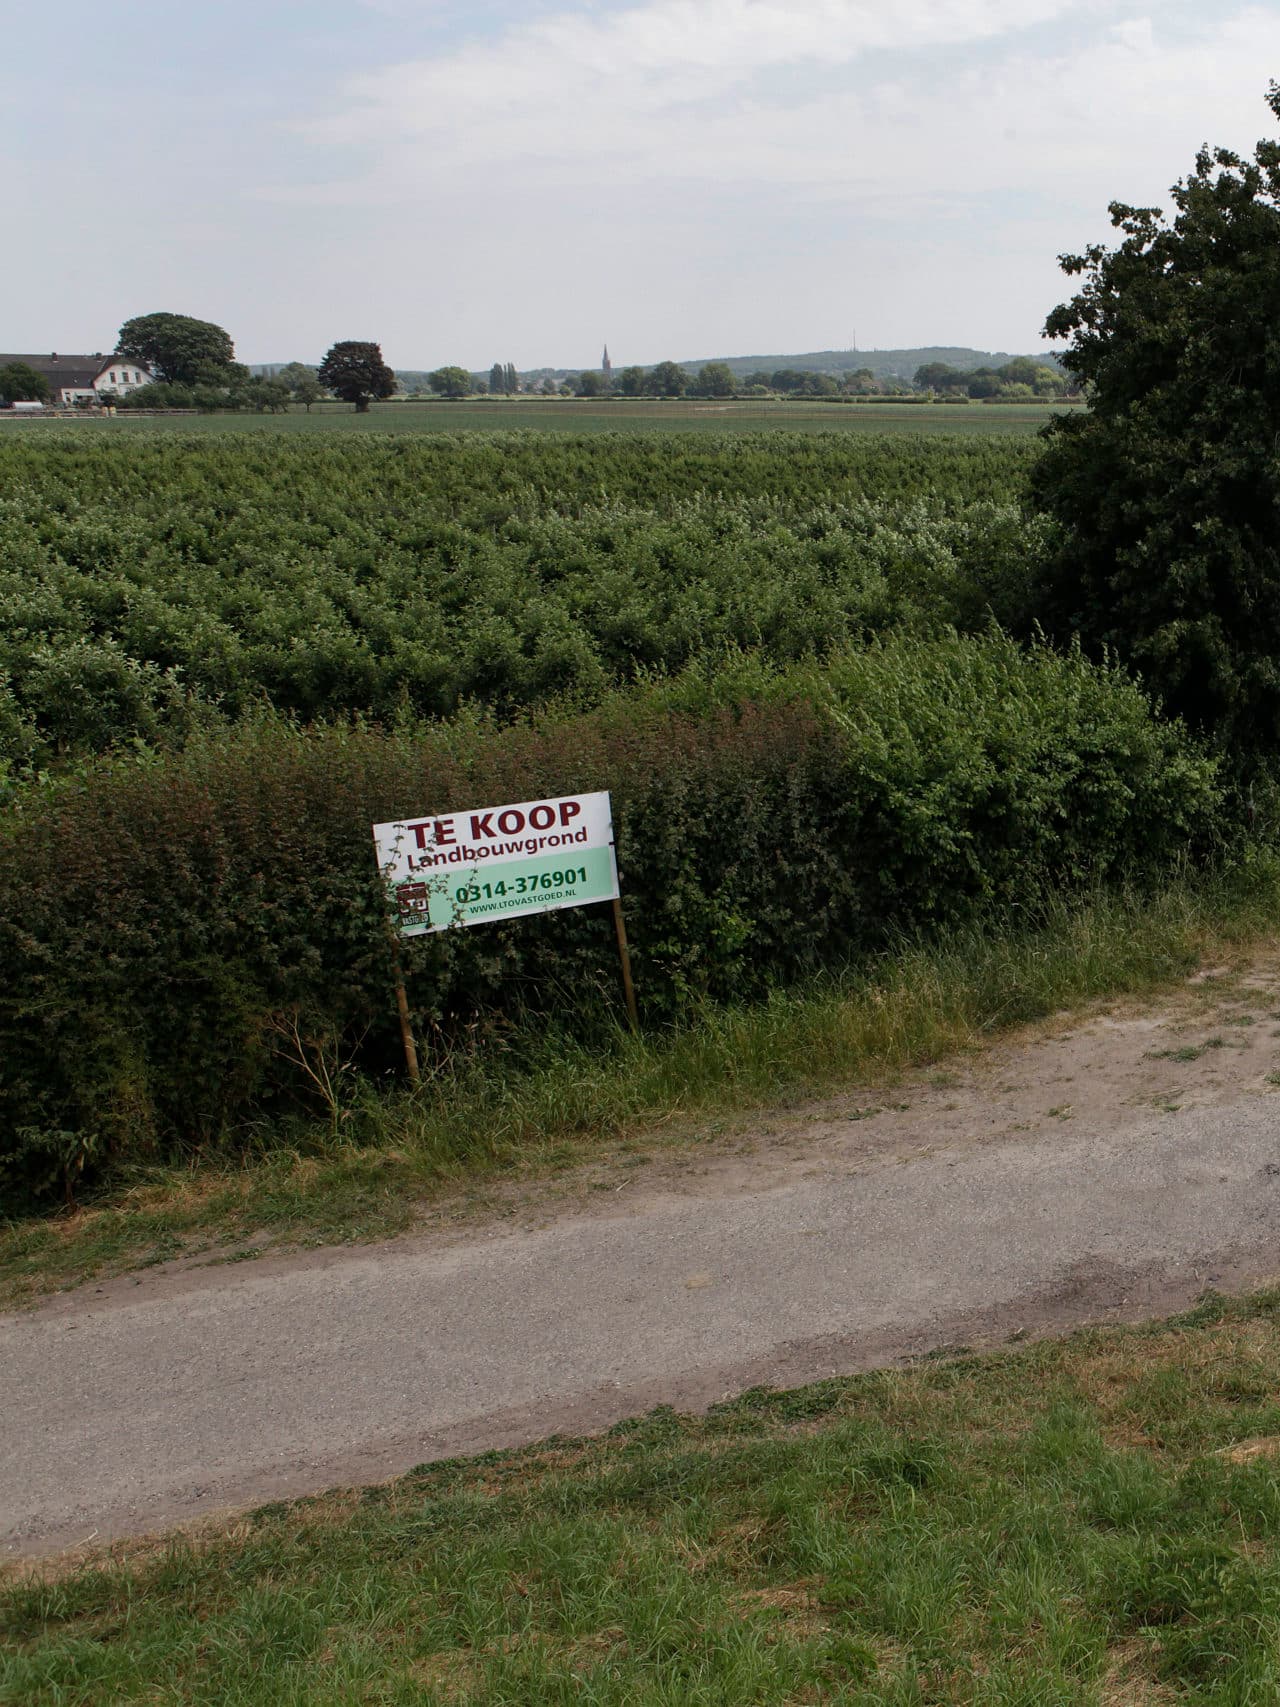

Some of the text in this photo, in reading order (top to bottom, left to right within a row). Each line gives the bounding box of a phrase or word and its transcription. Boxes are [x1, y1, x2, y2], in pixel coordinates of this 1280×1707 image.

[407, 801, 581, 849] TE KOOP
[407, 826, 588, 870] Landbouwgrond
[455, 867, 587, 903] 0314-376901
[469, 889, 577, 914] WWW.LTOVASTGOED.NL
